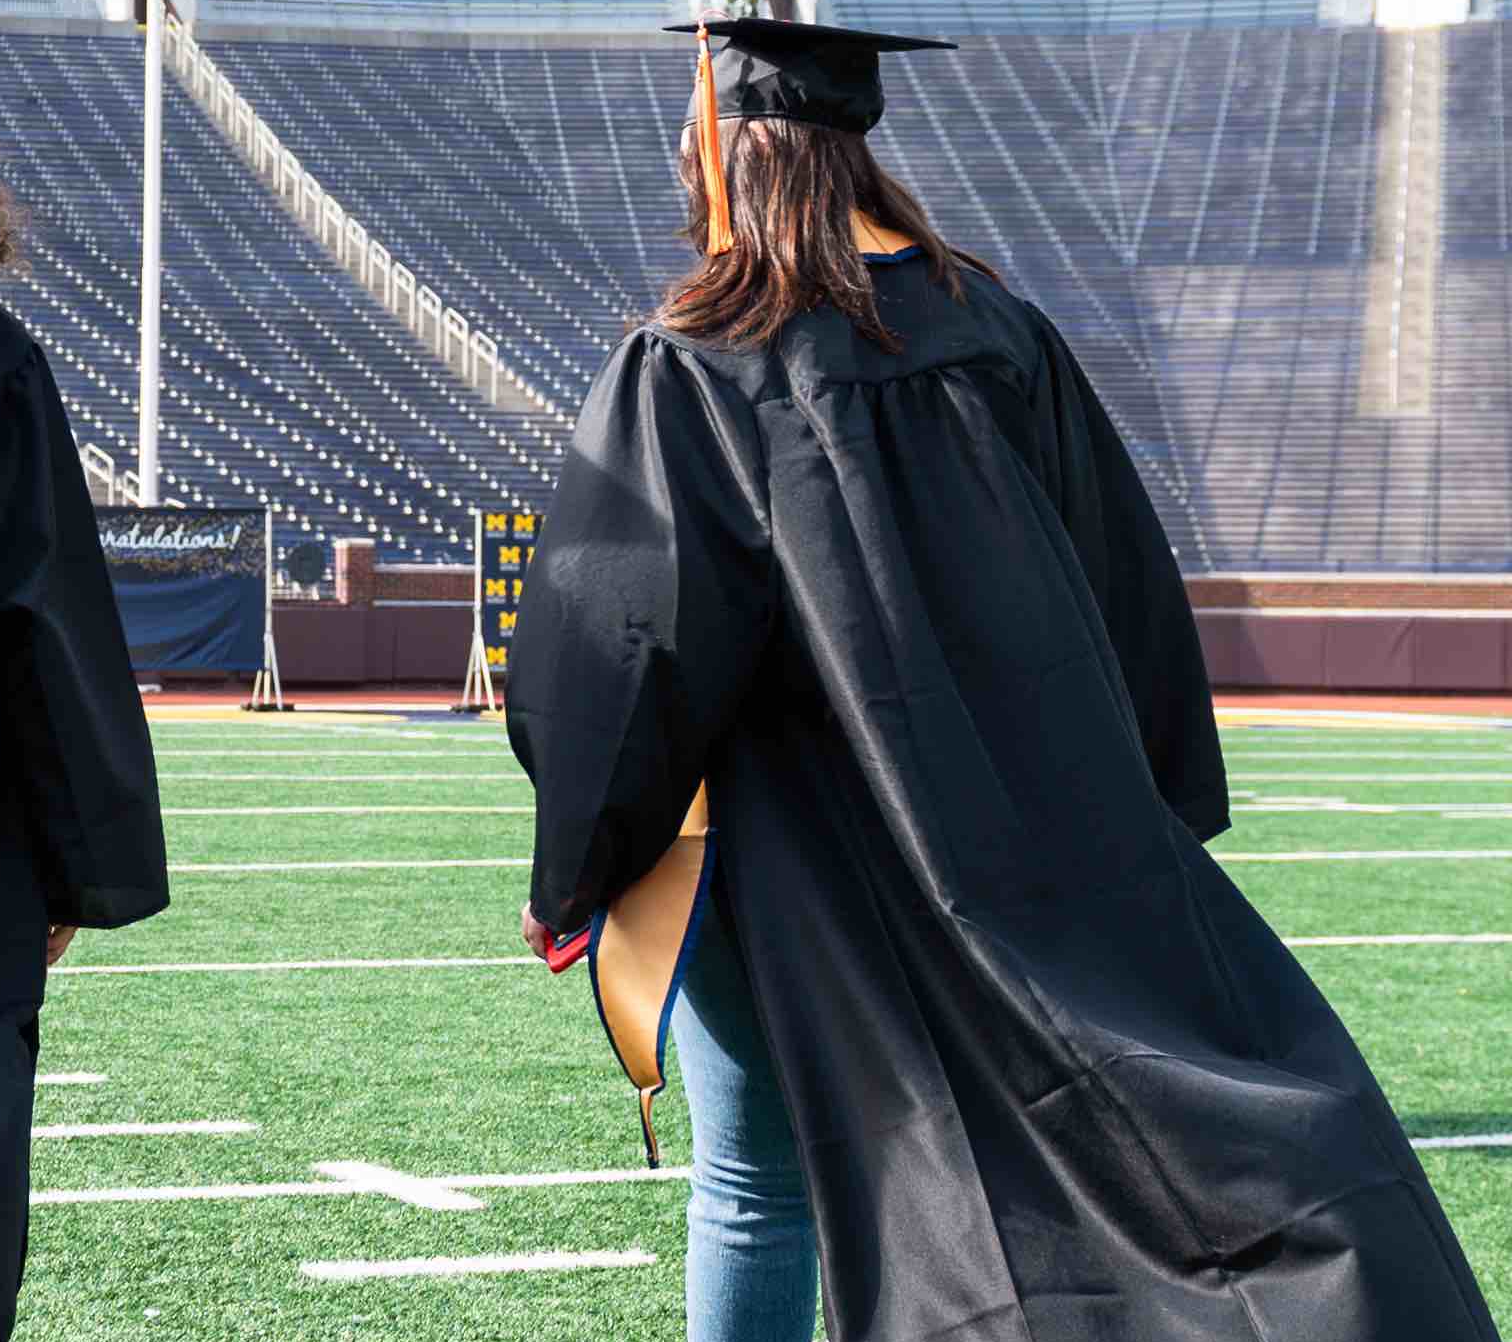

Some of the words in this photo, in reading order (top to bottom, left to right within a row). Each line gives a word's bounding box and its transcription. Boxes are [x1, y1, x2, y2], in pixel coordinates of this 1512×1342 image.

[486, 514, 508, 532] M
[513, 514, 535, 532] M
[499, 546, 521, 564] M
[486, 579, 507, 596] M
[499, 611, 517, 629] M
[486, 646, 508, 665] M
